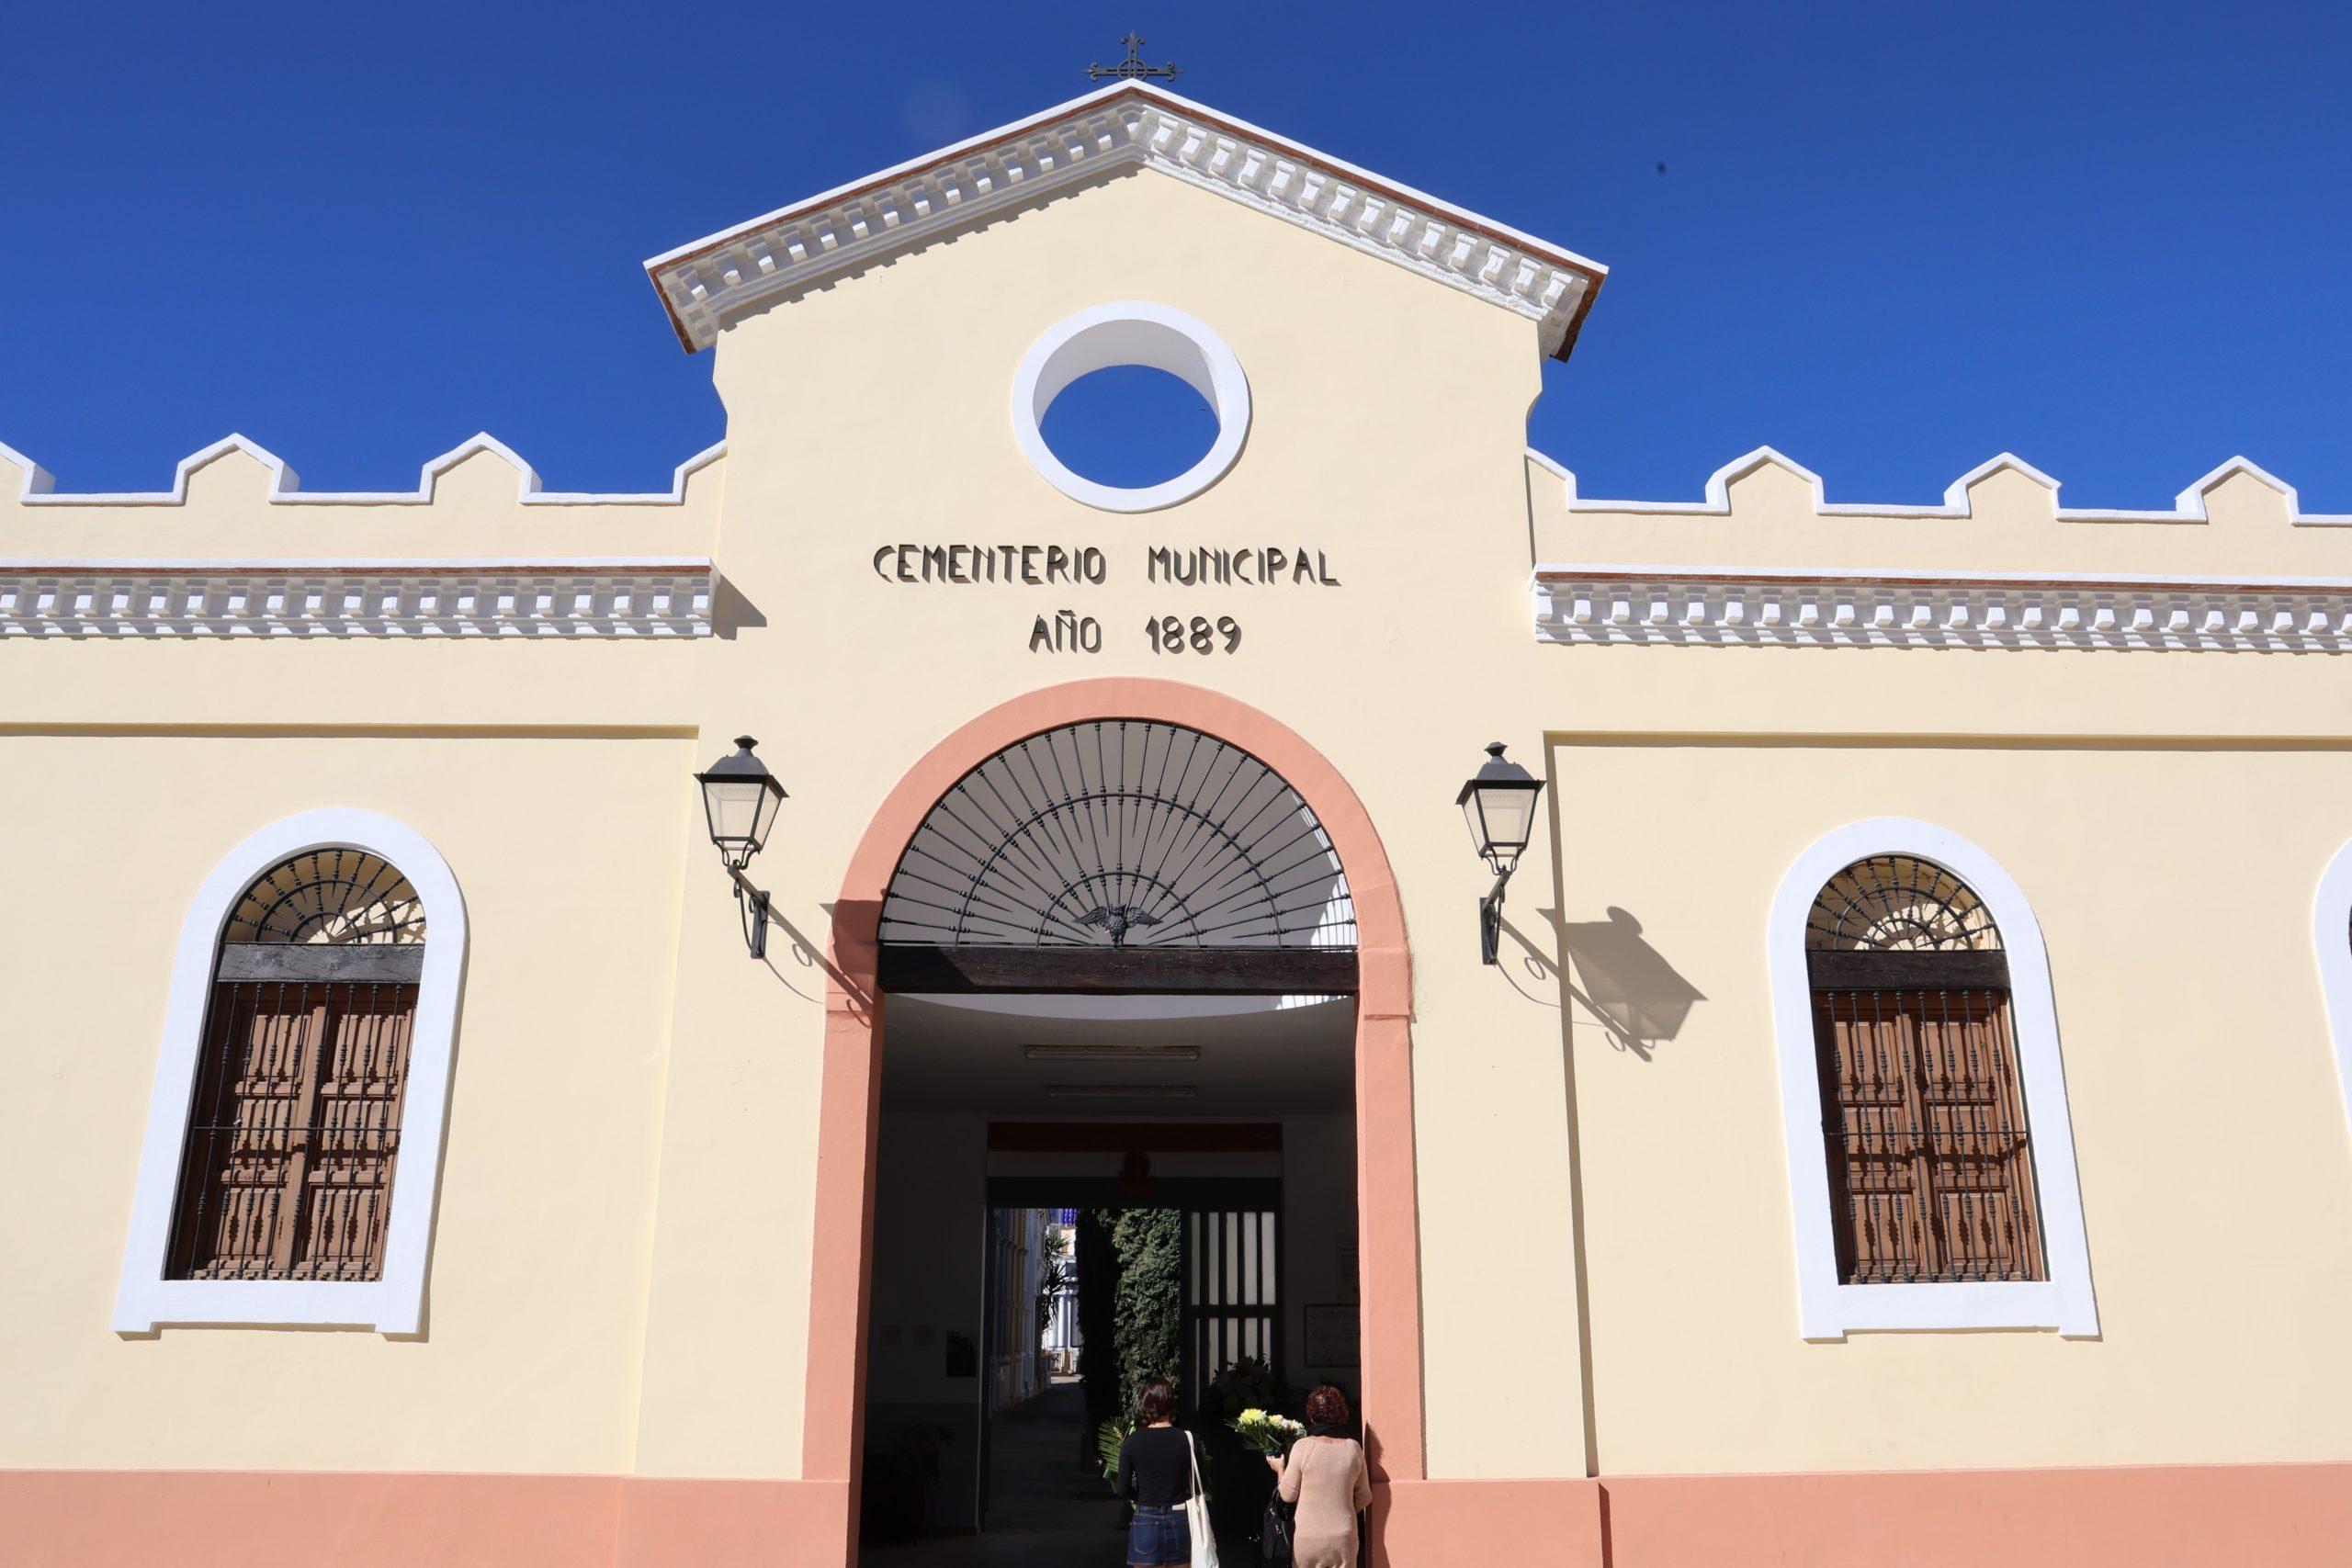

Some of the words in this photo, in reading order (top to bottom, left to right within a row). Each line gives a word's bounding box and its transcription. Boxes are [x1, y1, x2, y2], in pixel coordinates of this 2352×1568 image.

[874, 544, 1106, 584] CEMENTERIO
[1148, 546, 1341, 586] MUNICIPAL
[1029, 609, 1102, 653] AÑO
[1145, 615, 1242, 655] 1889
